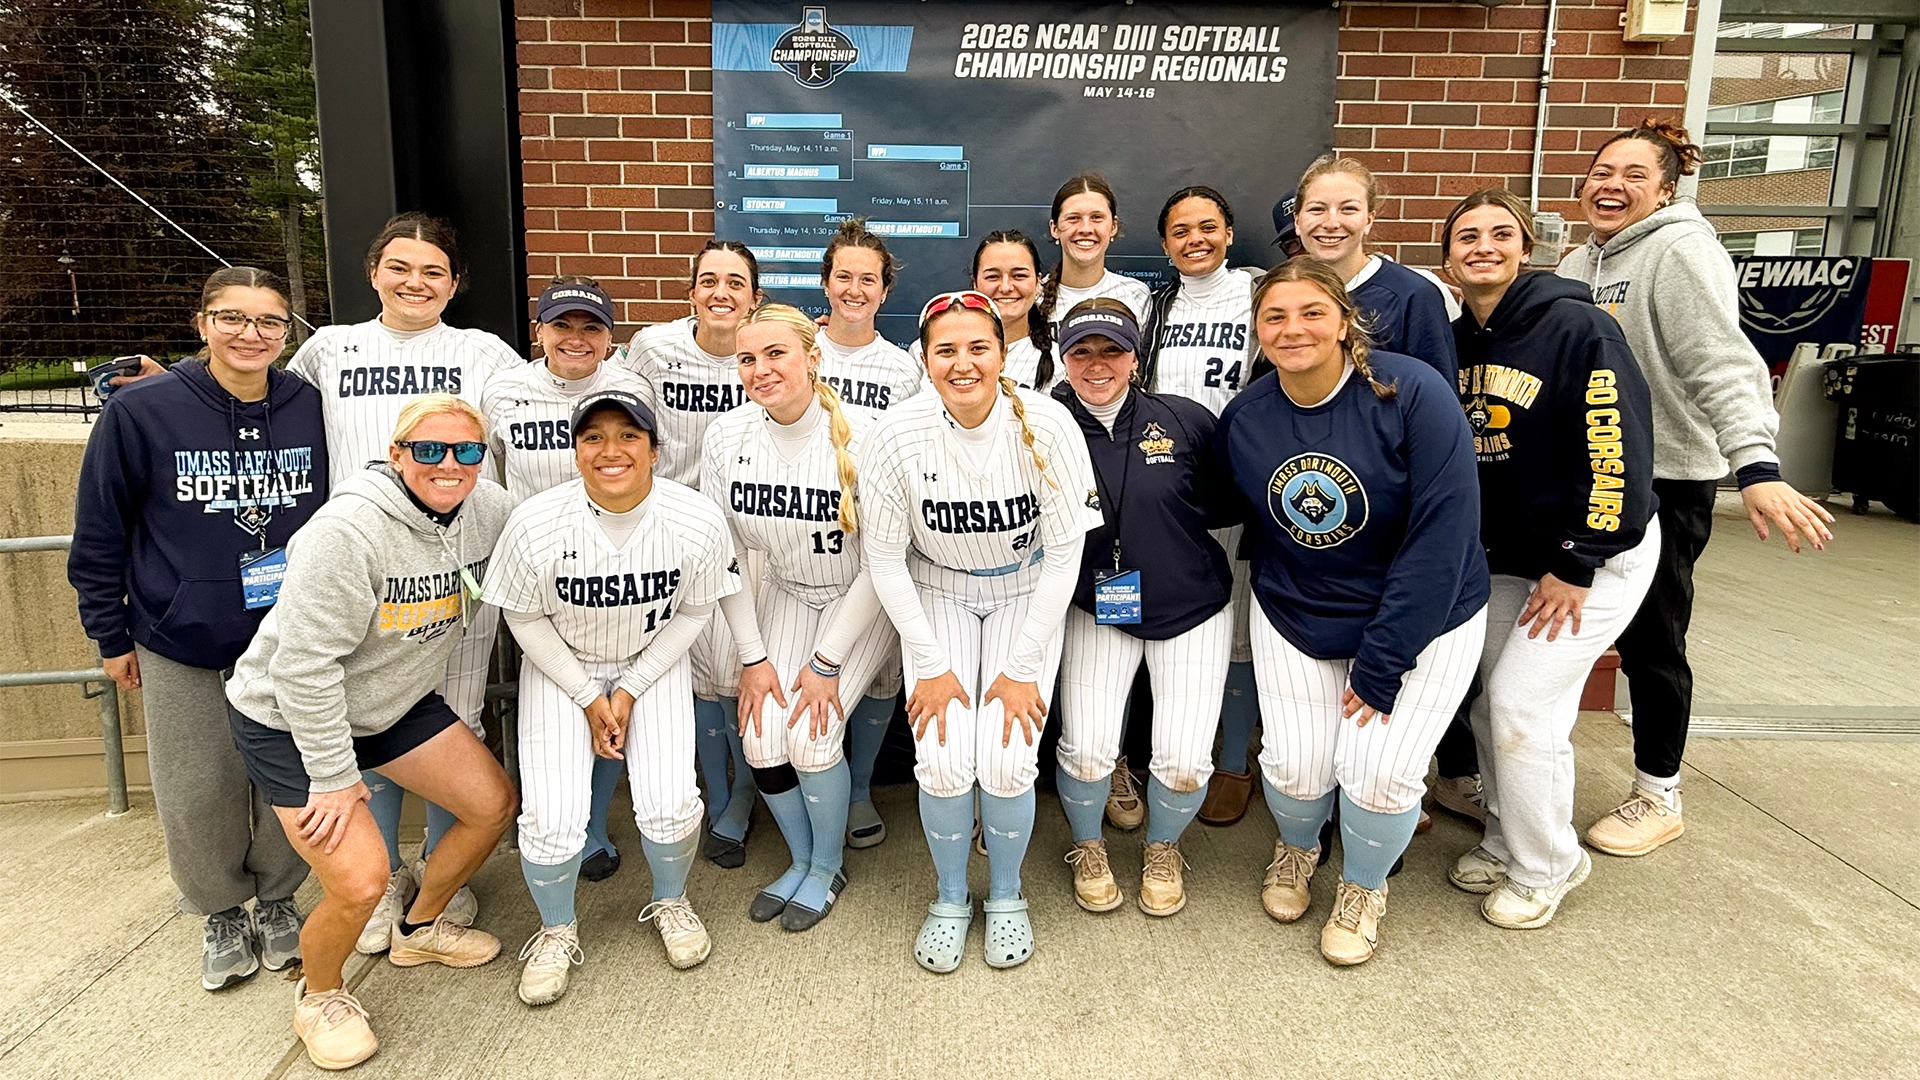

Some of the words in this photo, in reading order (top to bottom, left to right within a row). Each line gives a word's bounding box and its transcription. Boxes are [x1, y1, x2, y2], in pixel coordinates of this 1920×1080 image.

[791, 35, 816, 43] 2026
[817, 35, 837, 43] DIII
[961, 23, 1030, 50] 2026
[1112, 24, 1157, 51] DIII
[1161, 25, 1281, 53] SOFTBALL
[773, 49, 857, 62] CHAMPIONSHIP
[954, 52, 1146, 81] CHAMPIONSHIP
[1150, 55, 1288, 83] REGIONALS
[1083, 86, 1113, 98] MAY
[1116, 87, 1155, 99] 14-16
[750, 116, 766, 126] WPI
[823, 131, 846, 139] Game
[750, 144, 785, 153] Thursday,
[786, 144, 801, 153] May
[871, 147, 887, 157] WPI
[747, 167, 785, 177] ALBERTUS
[786, 168, 819, 177] MAGNUS
[940, 162, 962, 170] Game
[963, 162, 968, 170] 3
[746, 200, 786, 209] STOCKTON
[871, 197, 895, 205] Friday,
[897, 198, 911, 206] May
[824, 214, 846, 222] Game
[749, 226, 783, 235] Thursday,
[784, 227, 798, 235] May
[896, 225, 943, 234] DARTMOUTH
[750, 249, 774, 258] MASS
[775, 249, 822, 259] DARTMOUTH
[759, 275, 788, 285] BERTUS
[790, 276, 822, 285] MAGNUS
[1124, 270, 1162, 279] necessary)
[551, 289, 603, 305] CORSAIRS
[1068, 313, 1123, 329] CORSAIRS
[339, 365, 462, 398] CORSAIRS
[1204, 357, 1243, 390] 24
[820, 376, 891, 411] SAIRS
[1472, 364, 1543, 410] DRTMOUTH
[1585, 368, 1619, 406] GO
[662, 381, 750, 413] CORSAI
[510, 419, 575, 451] CORS
[1473, 432, 1511, 453] SAIRS
[174, 450, 231, 476] UMASS
[235, 446, 312, 475] DARTMOUTH
[1145, 455, 1176, 465] SOFTBALL
[1271, 462, 1298, 495] UMASS
[1300, 457, 1358, 495] DARTMOUTH
[1585, 407, 1626, 532] CORSAIRS
[176, 469, 313, 501] SOFTBALL
[730, 481, 842, 522] CORSAIRS
[921, 490, 1042, 534] CORSAIRS
[811, 529, 844, 555] 13
[1290, 523, 1354, 545] CORSAIRS
[243, 571, 283, 586] PARTICIPA
[555, 568, 681, 608] CORSAIRS
[1096, 593, 1140, 602] PARTICIPANT
